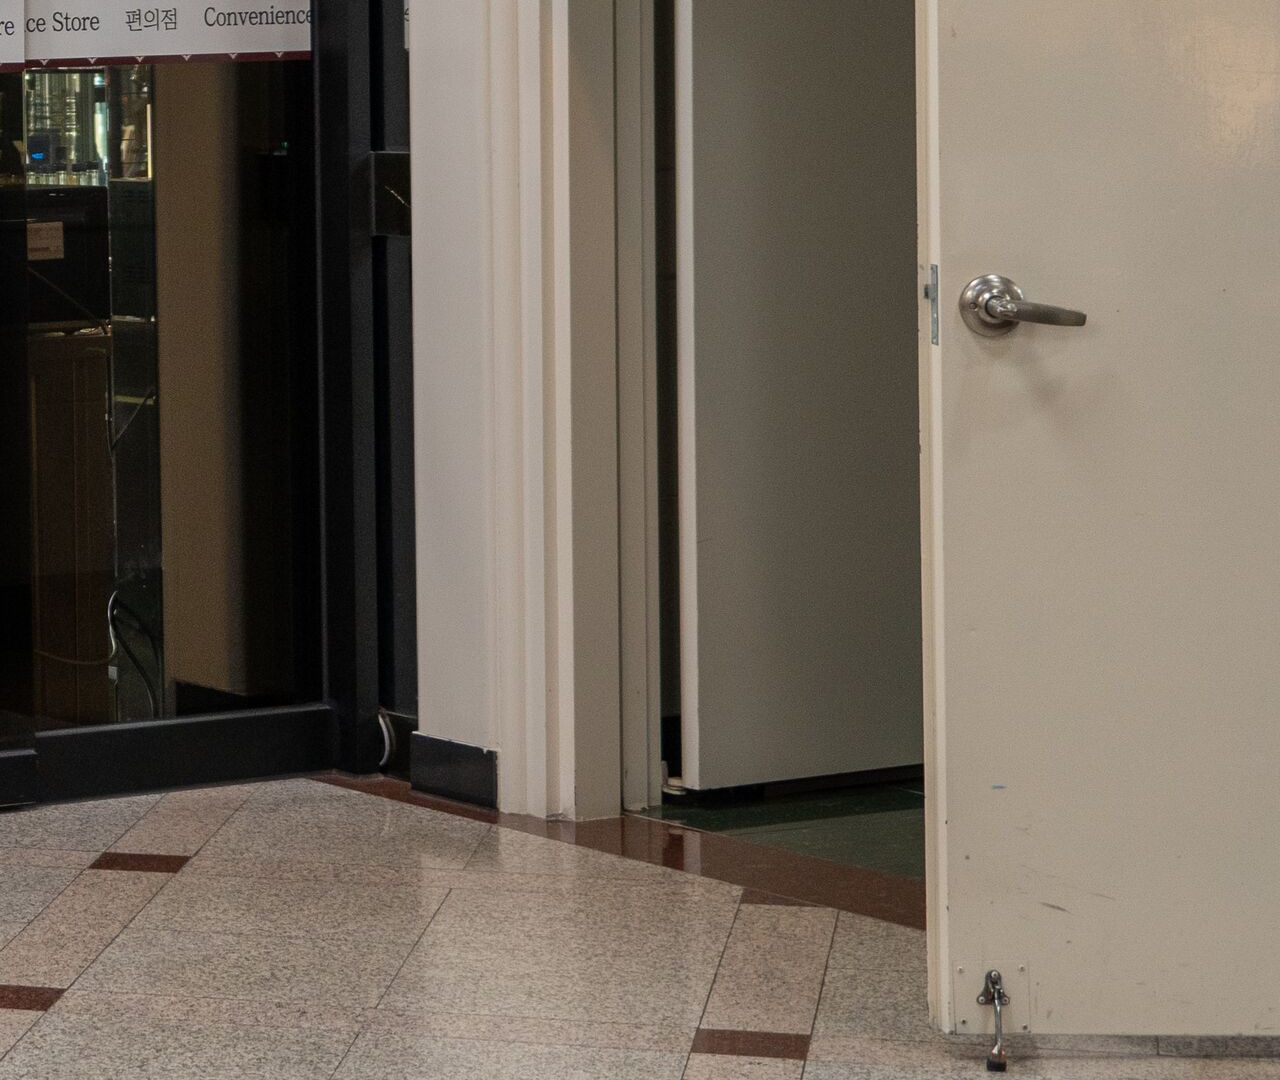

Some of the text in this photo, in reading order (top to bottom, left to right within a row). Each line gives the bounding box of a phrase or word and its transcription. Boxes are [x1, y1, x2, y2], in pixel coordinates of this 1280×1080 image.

[52, 11, 100, 32] Store
[125, 8, 178, 32] 편의점
[204, 4, 311, 27] Convenience
